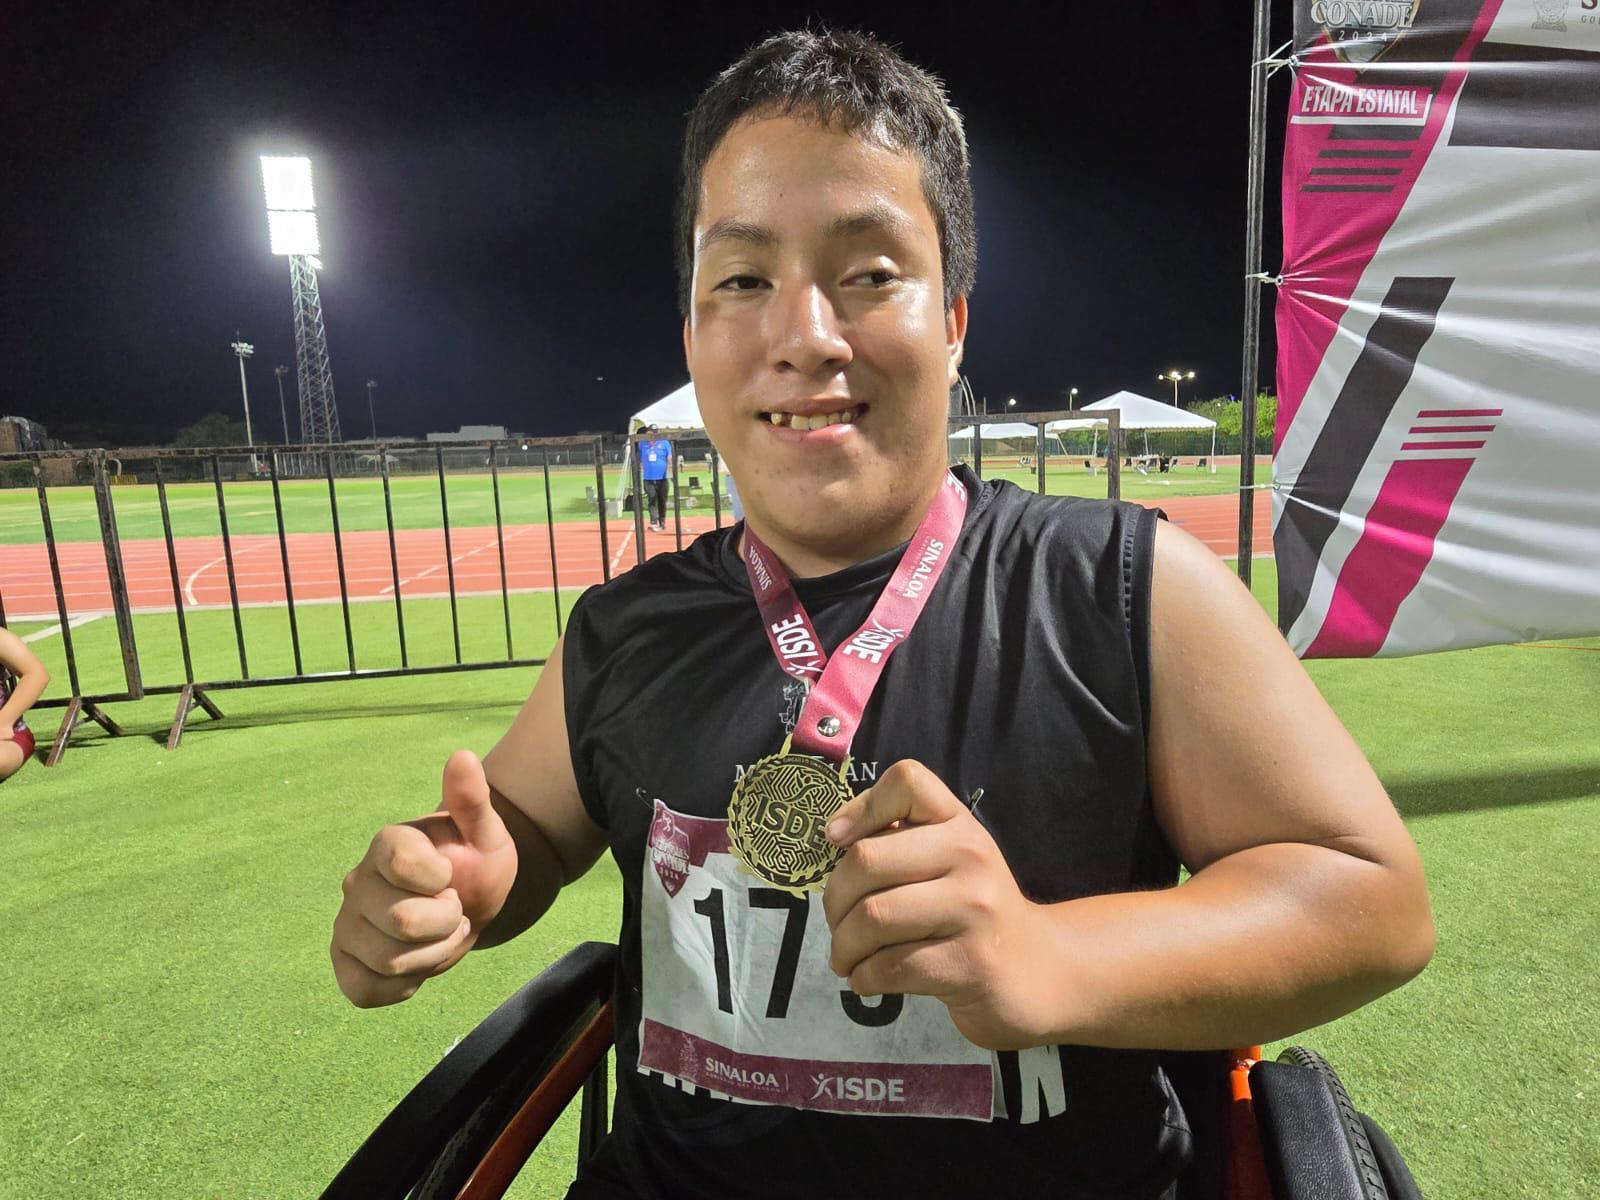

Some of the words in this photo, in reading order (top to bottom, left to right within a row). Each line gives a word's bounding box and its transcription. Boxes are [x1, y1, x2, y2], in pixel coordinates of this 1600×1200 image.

[1311, 0, 1412, 28] CONADE
[1338, 30, 1388, 42] 2024
[1301, 85, 1354, 113] ETAPA
[1356, 88, 1418, 114] ESTATAL
[749, 545, 772, 591] SINALOA
[902, 538, 944, 598] SINALOA
[771, 613, 819, 660] ISDE
[754, 796, 828, 851] ISDE
[705, 1057, 779, 1087] SINALOA
[837, 1077, 905, 1102] ISDE
